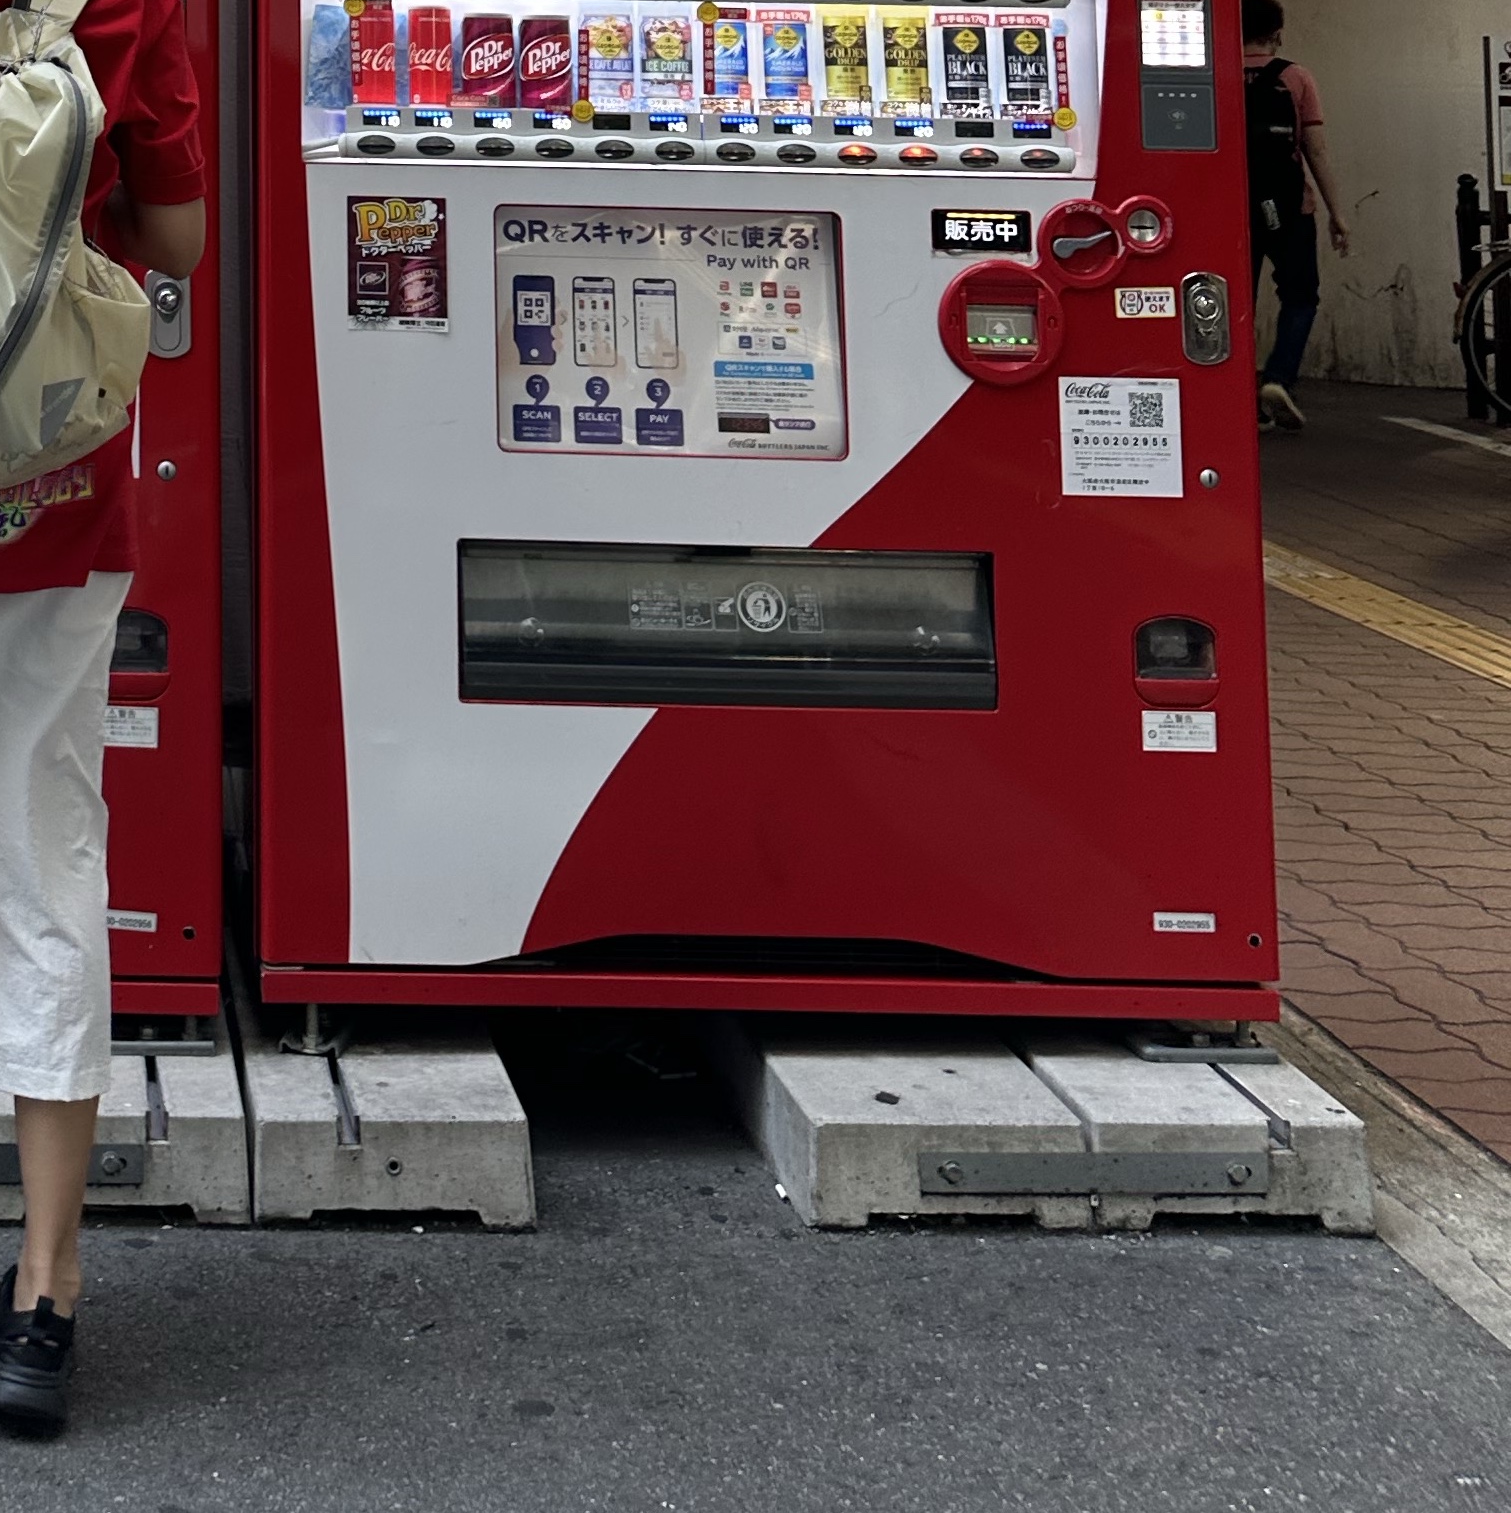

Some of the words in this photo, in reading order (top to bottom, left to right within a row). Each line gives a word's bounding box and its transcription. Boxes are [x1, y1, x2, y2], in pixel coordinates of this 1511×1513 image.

[483, 40, 504, 57] Dr
[541, 40, 561, 58] Dr
[826, 48, 867, 59] GOLDEN
[885, 49, 927, 60] GOLDEN
[470, 47, 513, 74] Pepper
[528, 48, 571, 74] Pepper
[645, 60, 660, 71] ICE
[661, 60, 689, 72] COFFEE
[837, 57, 859, 65] DRIP
[897, 59, 920, 67] DRIP
[948, 61, 987, 75] BLACK
[1008, 62, 1047, 76] BLACK
[502, 219, 666, 245] QRをスキャン!
[677, 223, 819, 251] すぐに使える!
[944, 220, 1018, 242] 販売中
[706, 254, 736, 271] Pay
[741, 254, 779, 270] with
[785, 256, 810, 270] QR
[1148, 303, 1167, 314] OK
[1065, 382, 1111, 399] Coca-Cola
[522, 410, 552, 420] SCAN
[578, 411, 619, 422] SELECT
[649, 414, 669, 423] PAY
